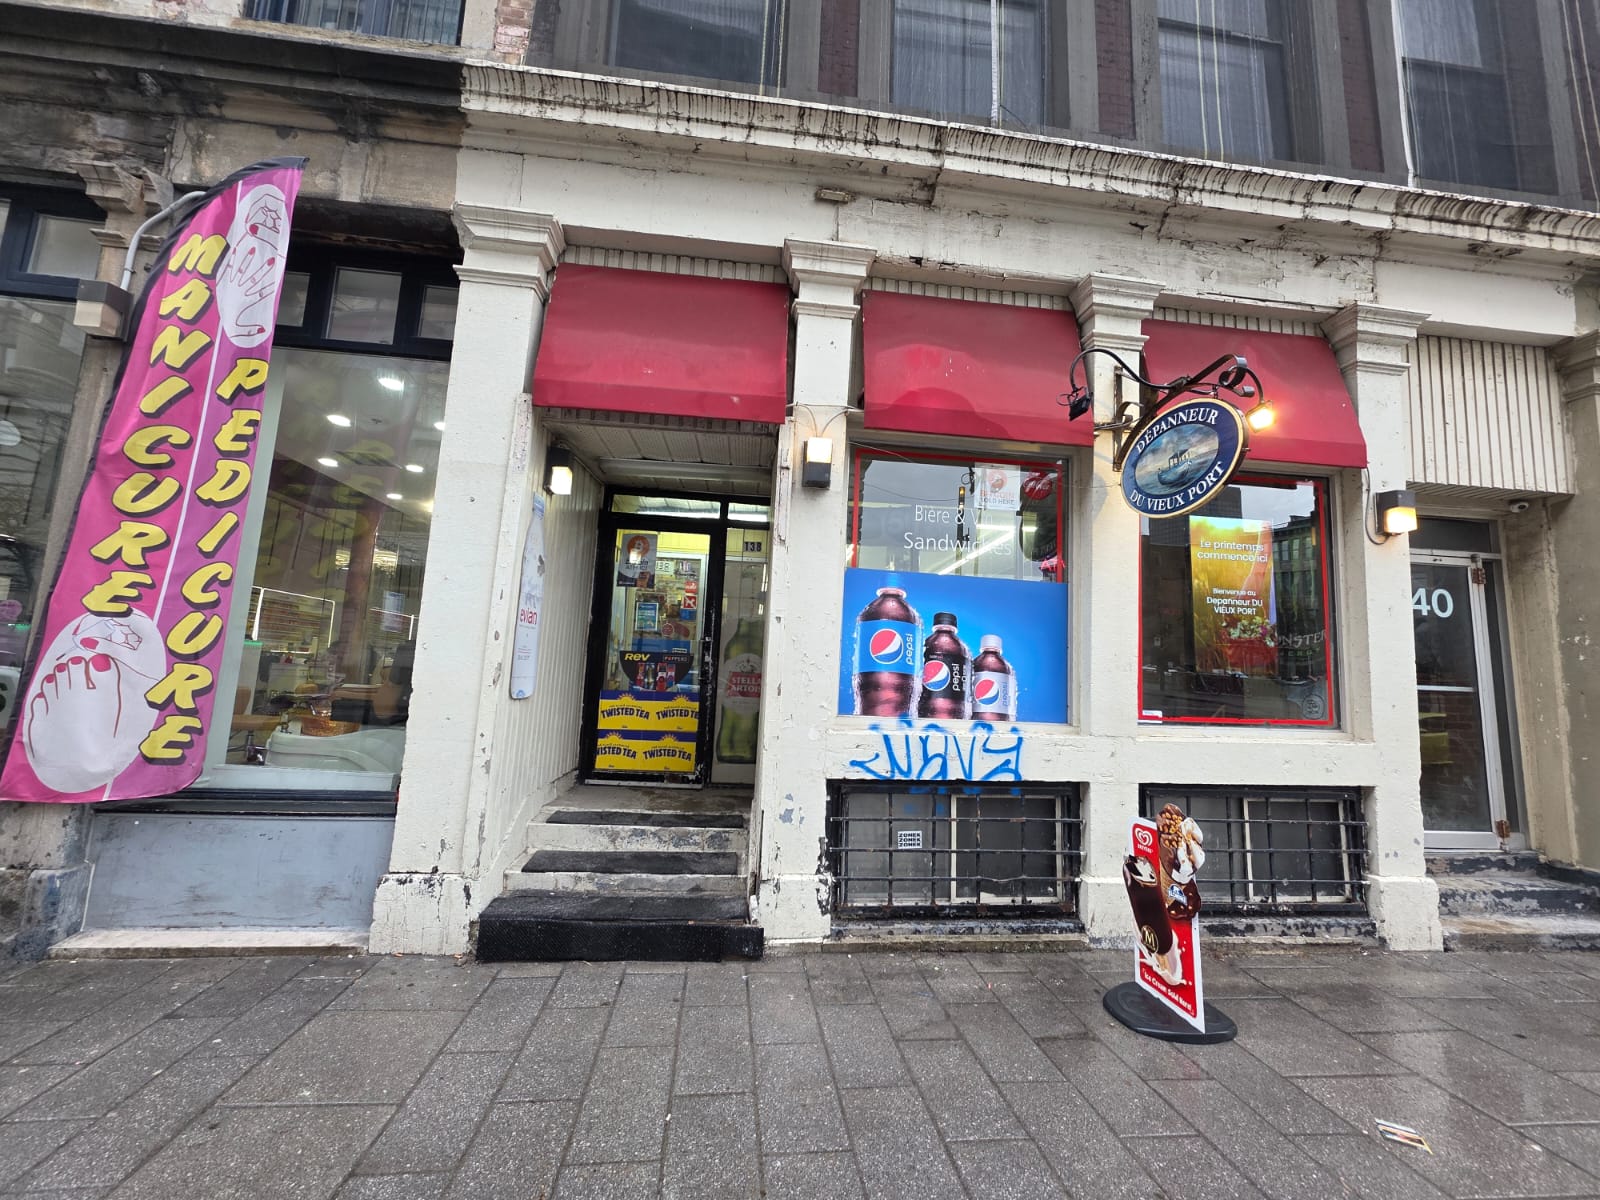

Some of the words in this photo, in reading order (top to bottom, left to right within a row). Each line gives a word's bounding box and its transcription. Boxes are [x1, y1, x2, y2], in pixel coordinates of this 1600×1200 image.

[82, 233, 228, 617] MANICURE
[1135, 407, 1219, 454] DÉPANNEUR
[1129, 489, 1145, 507] DU
[1147, 492, 1185, 511] VIEUX
[1187, 460, 1225, 501] PORT
[954, 507, 966, 526] &
[1200, 539, 1211, 549] Le
[1213, 540, 1265, 552] printemps
[138, 358, 268, 765] PEDICURE
[1213, 606, 1235, 615] VIEUX
[1236, 607, 1257, 616] PORT
[1251, 598, 1263, 607] DU
[519, 607, 538, 626] evian
[1277, 629, 1328, 649] NSTER
[905, 633, 914, 666] pepsi
[951, 663, 961, 692] pepsi
[601, 707, 635, 720] TWISTED
[636, 708, 650, 721] TEA
[656, 709, 690, 721] TWISTED
[690, 710, 699, 720] TE
[623, 747, 637, 759] TEA
[643, 748, 677, 760] TWISTED
[677, 750, 691, 762] TEA
[1151, 977, 1167, 993] Cream
[1167, 988, 1179, 1001] Sold
